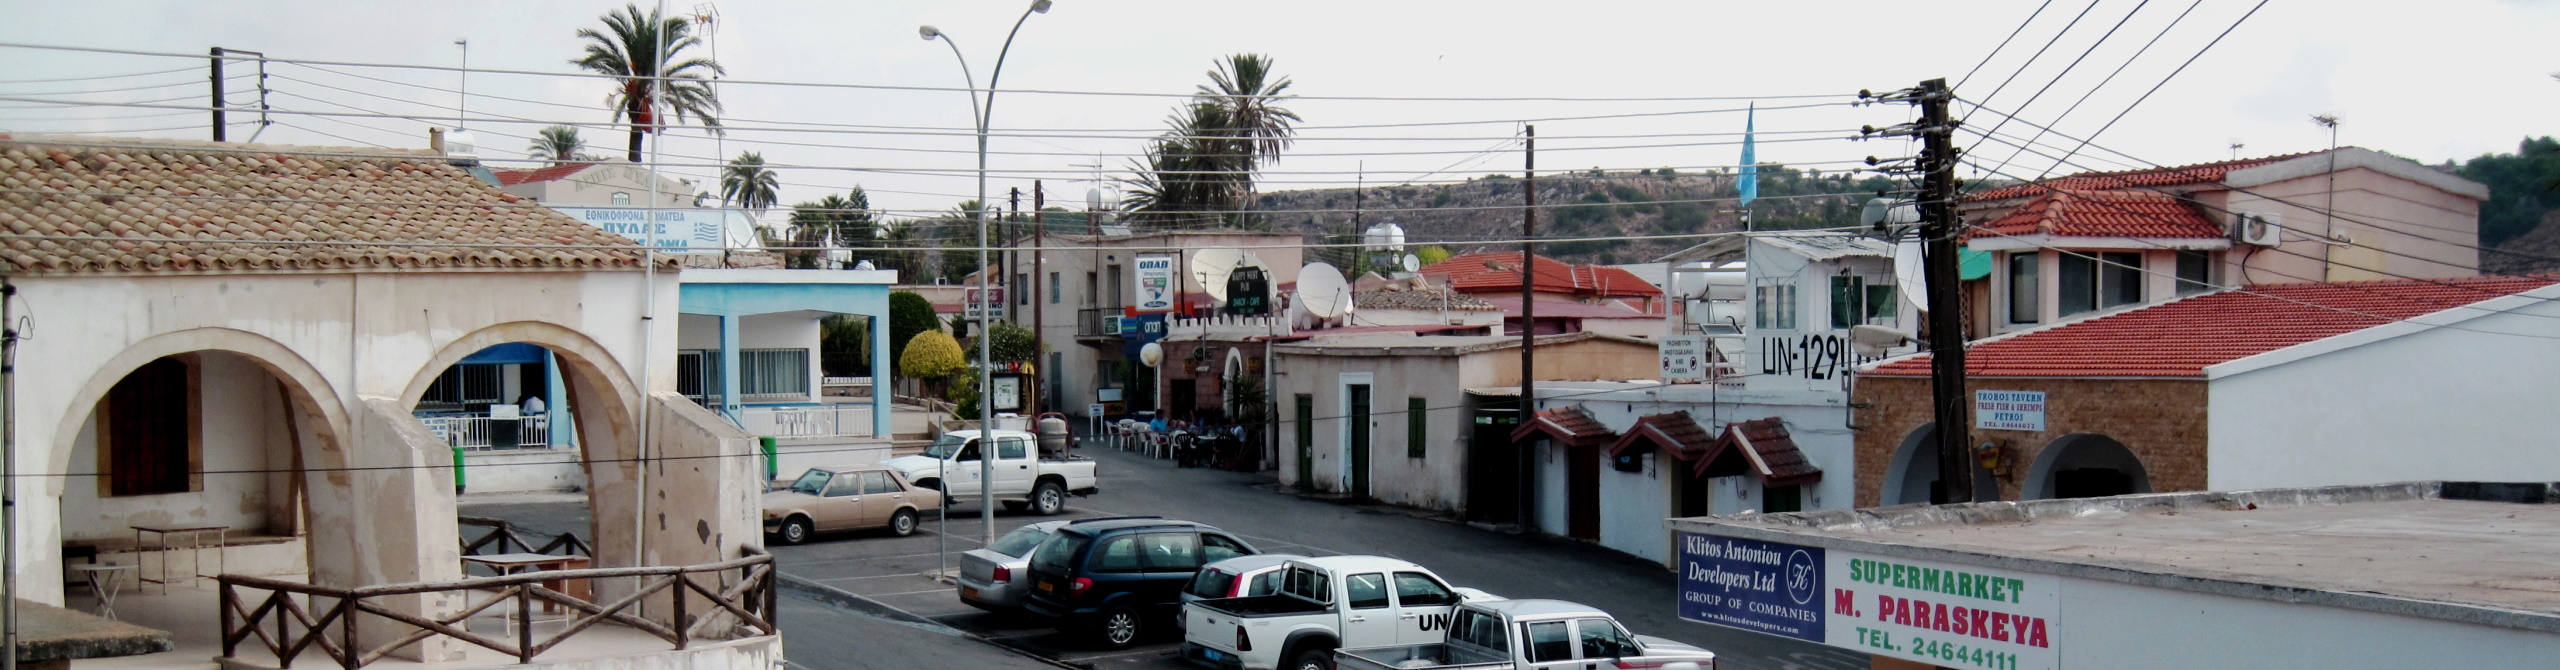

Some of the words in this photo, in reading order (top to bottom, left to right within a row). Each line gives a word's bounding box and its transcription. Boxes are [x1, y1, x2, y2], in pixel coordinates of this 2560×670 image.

[1978, 402, 1995, 410] FRESH
[1996, 402, 2010, 411] FISH
[2016, 403, 2043, 412] SHRIMPS
[2011, 393, 2043, 402] TAVERN
[1994, 412, 2024, 421] PETROS
[1686, 535, 1722, 557] Klitos
[1724, 540, 1782, 566] Antoniou
[1688, 561, 1750, 592] Developers
[1753, 570, 1776, 592] Ltd
[1850, 558, 2024, 604] SUPERMARKET
[1418, 613, 1448, 631] UN
[1685, 591, 1721, 606] GROUP
[1728, 598, 1742, 609] OF
[1749, 601, 1817, 622] COMPANIES
[1834, 588, 1861, 618] M.
[1878, 594, 2049, 648] PARASKEYA
[1701, 611, 1799, 634] www.klitosdevelopers.com
[1856, 626, 1902, 652] TEL.
[1912, 637, 2017, 670] 24644111
